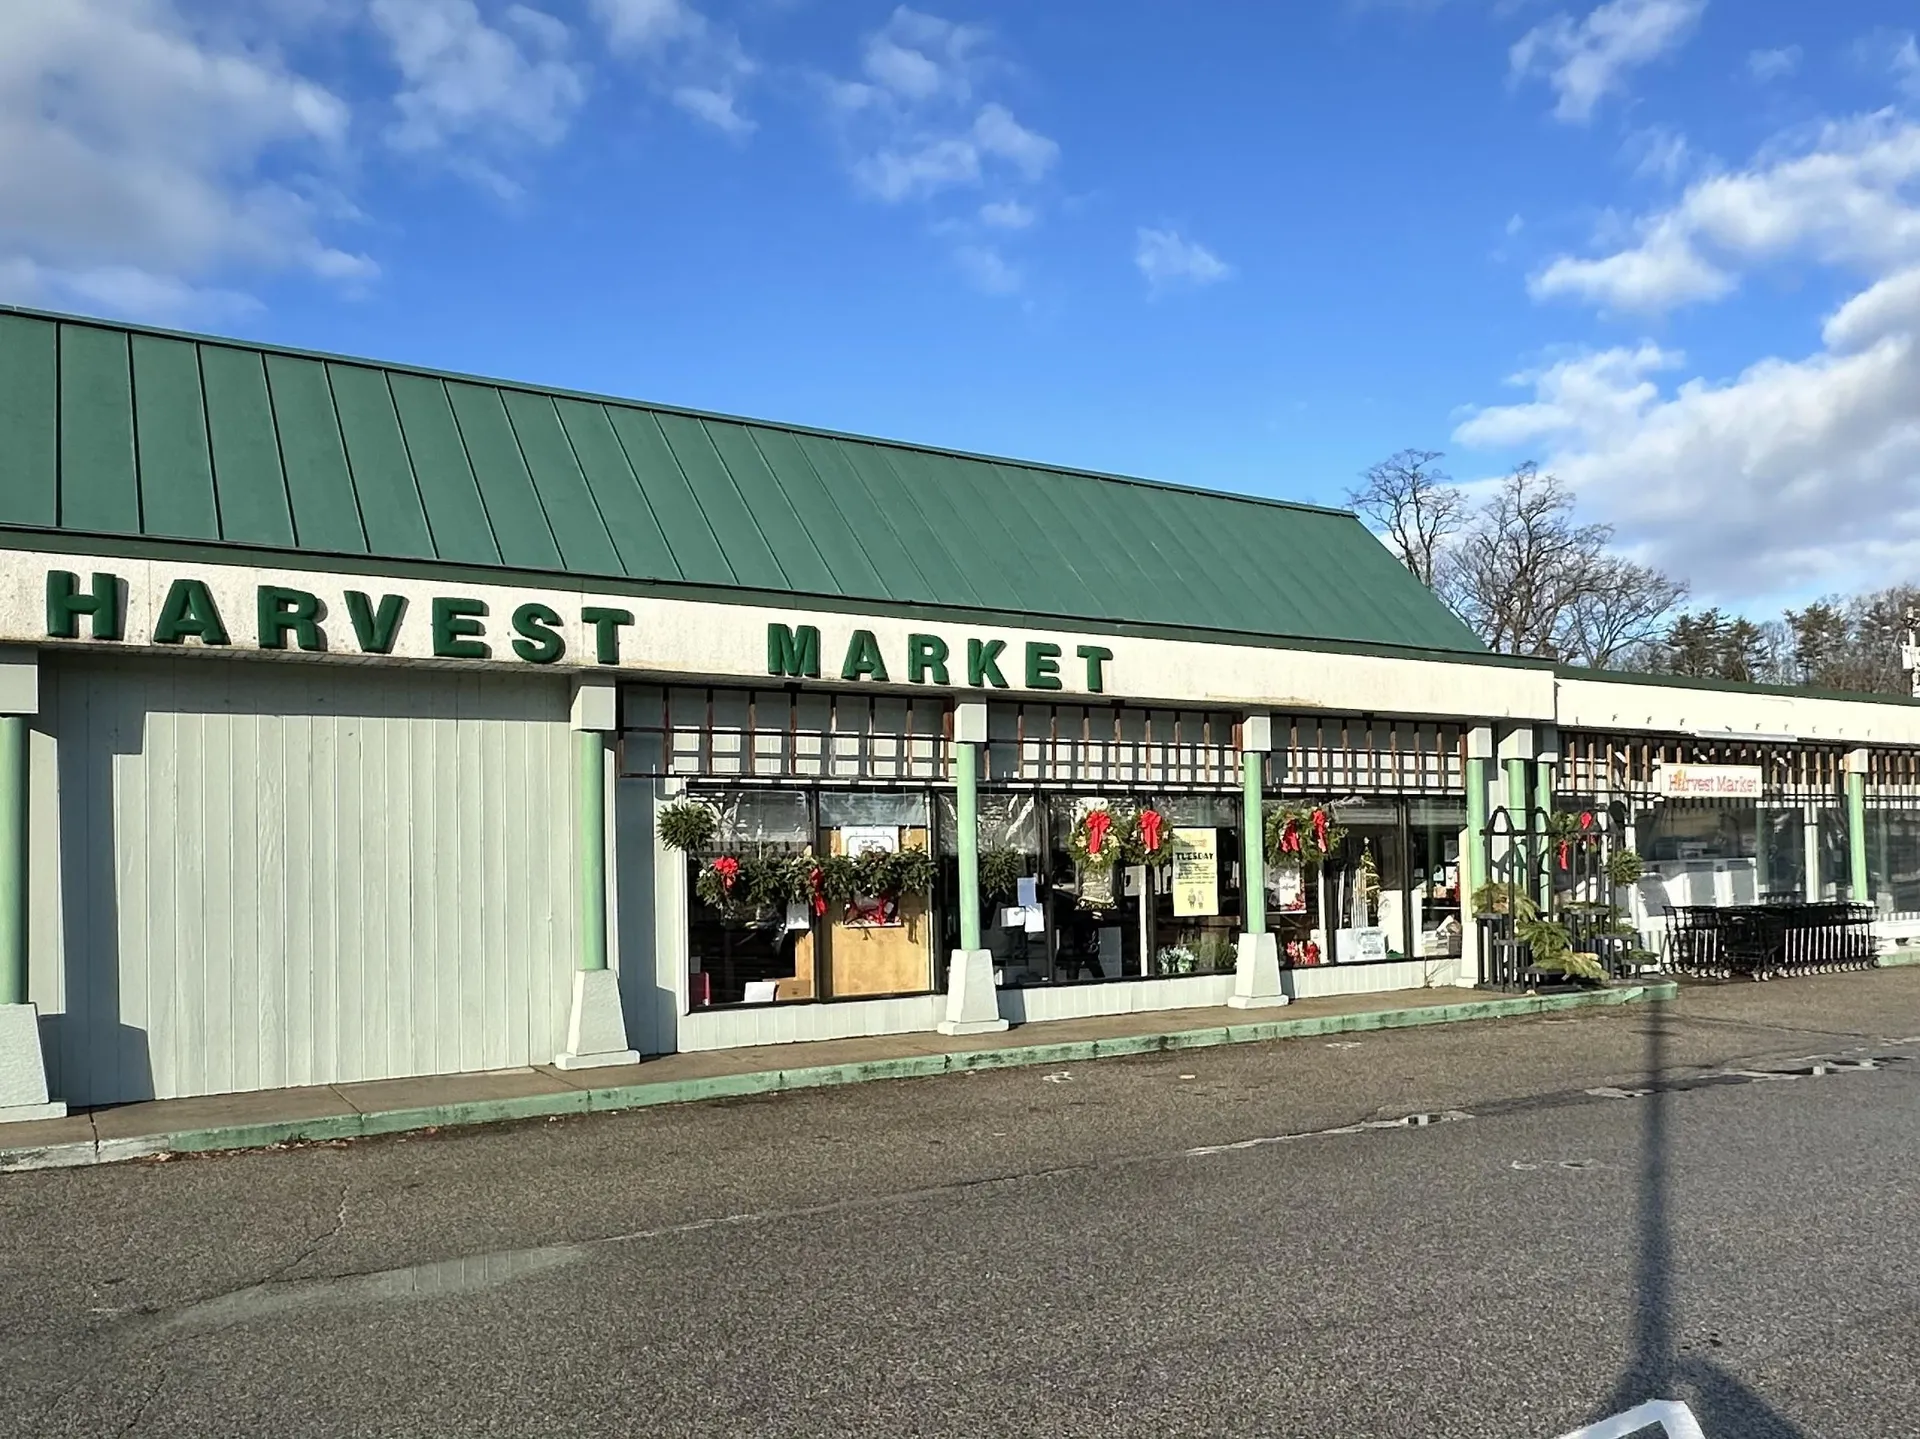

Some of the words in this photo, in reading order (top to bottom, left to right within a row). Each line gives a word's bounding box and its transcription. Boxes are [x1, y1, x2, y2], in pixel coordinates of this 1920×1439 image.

[46, 570, 636, 665] HARVEST
[768, 622, 1115, 692] MARKET
[1716, 775, 1758, 793] Market
[1175, 851, 1214, 861] TUESDAY
